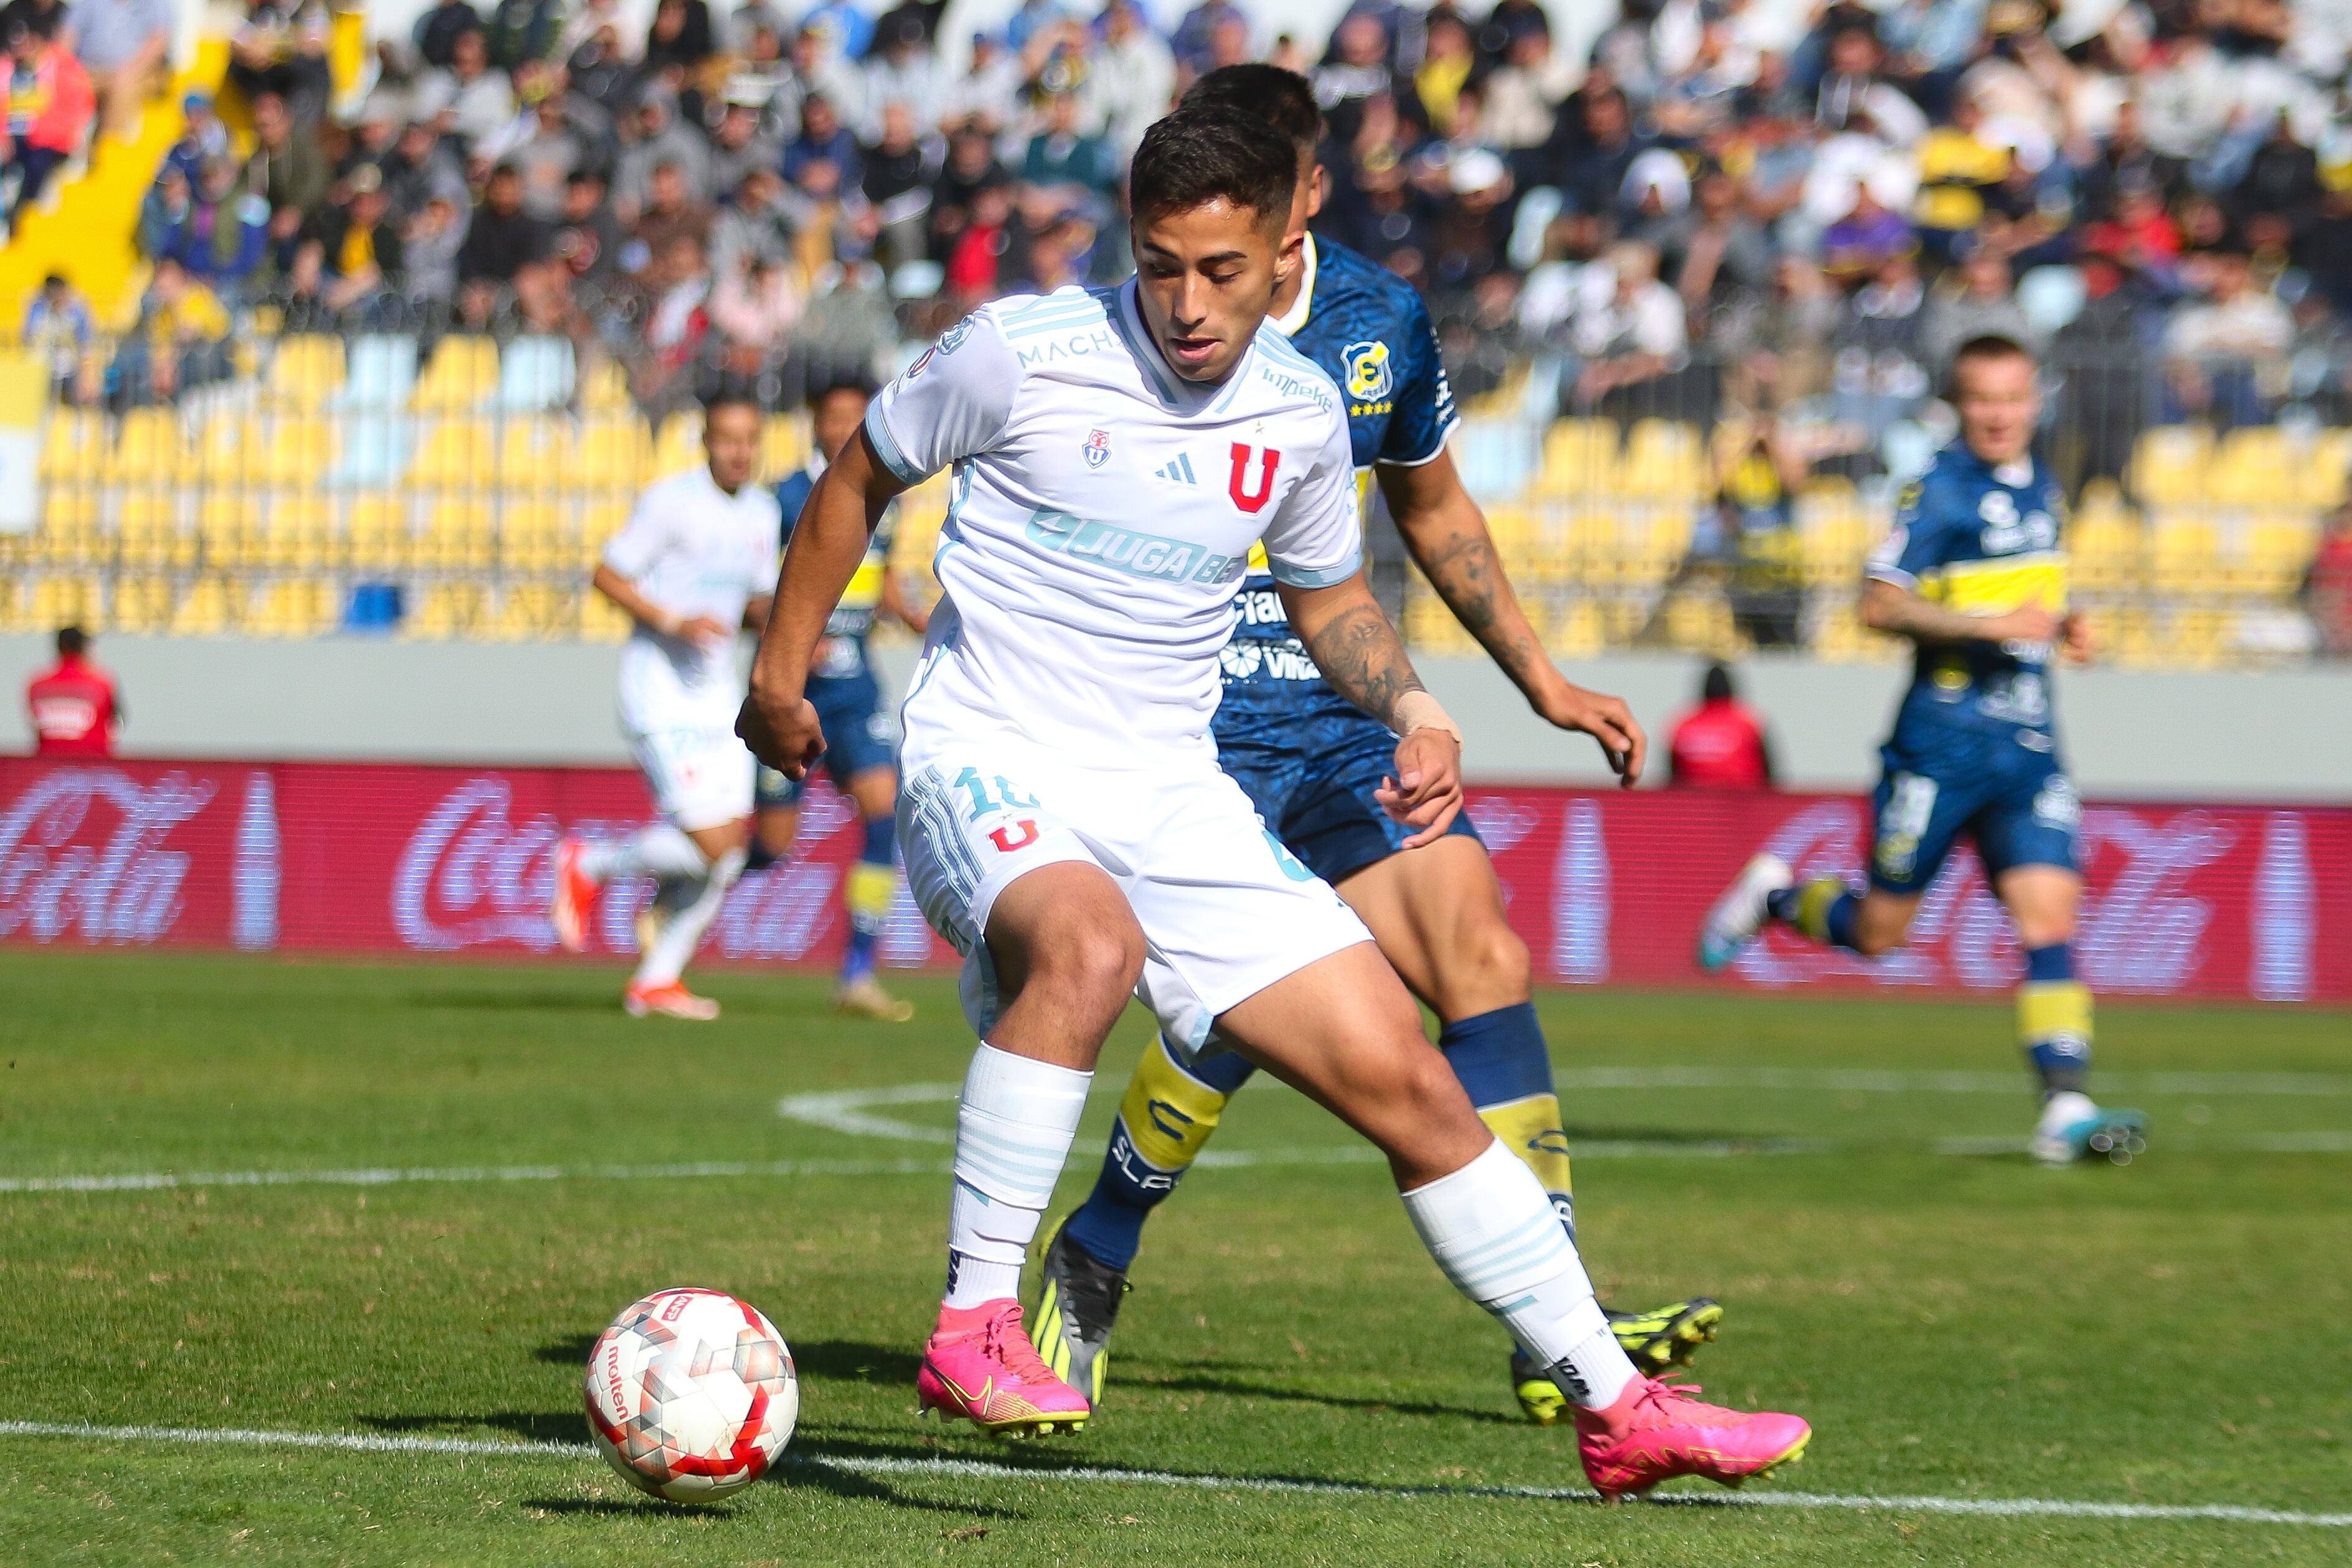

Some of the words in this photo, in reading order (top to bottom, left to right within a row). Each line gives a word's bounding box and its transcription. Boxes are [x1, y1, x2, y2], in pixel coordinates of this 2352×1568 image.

[1016, 329, 1122, 369] MACH
[1262, 367, 1333, 413] Impeke
[1228, 441, 1281, 514] U
[1074, 530, 1193, 578] JUGA
[985, 819, 1040, 853] U
[608, 1345, 629, 1420] molten
